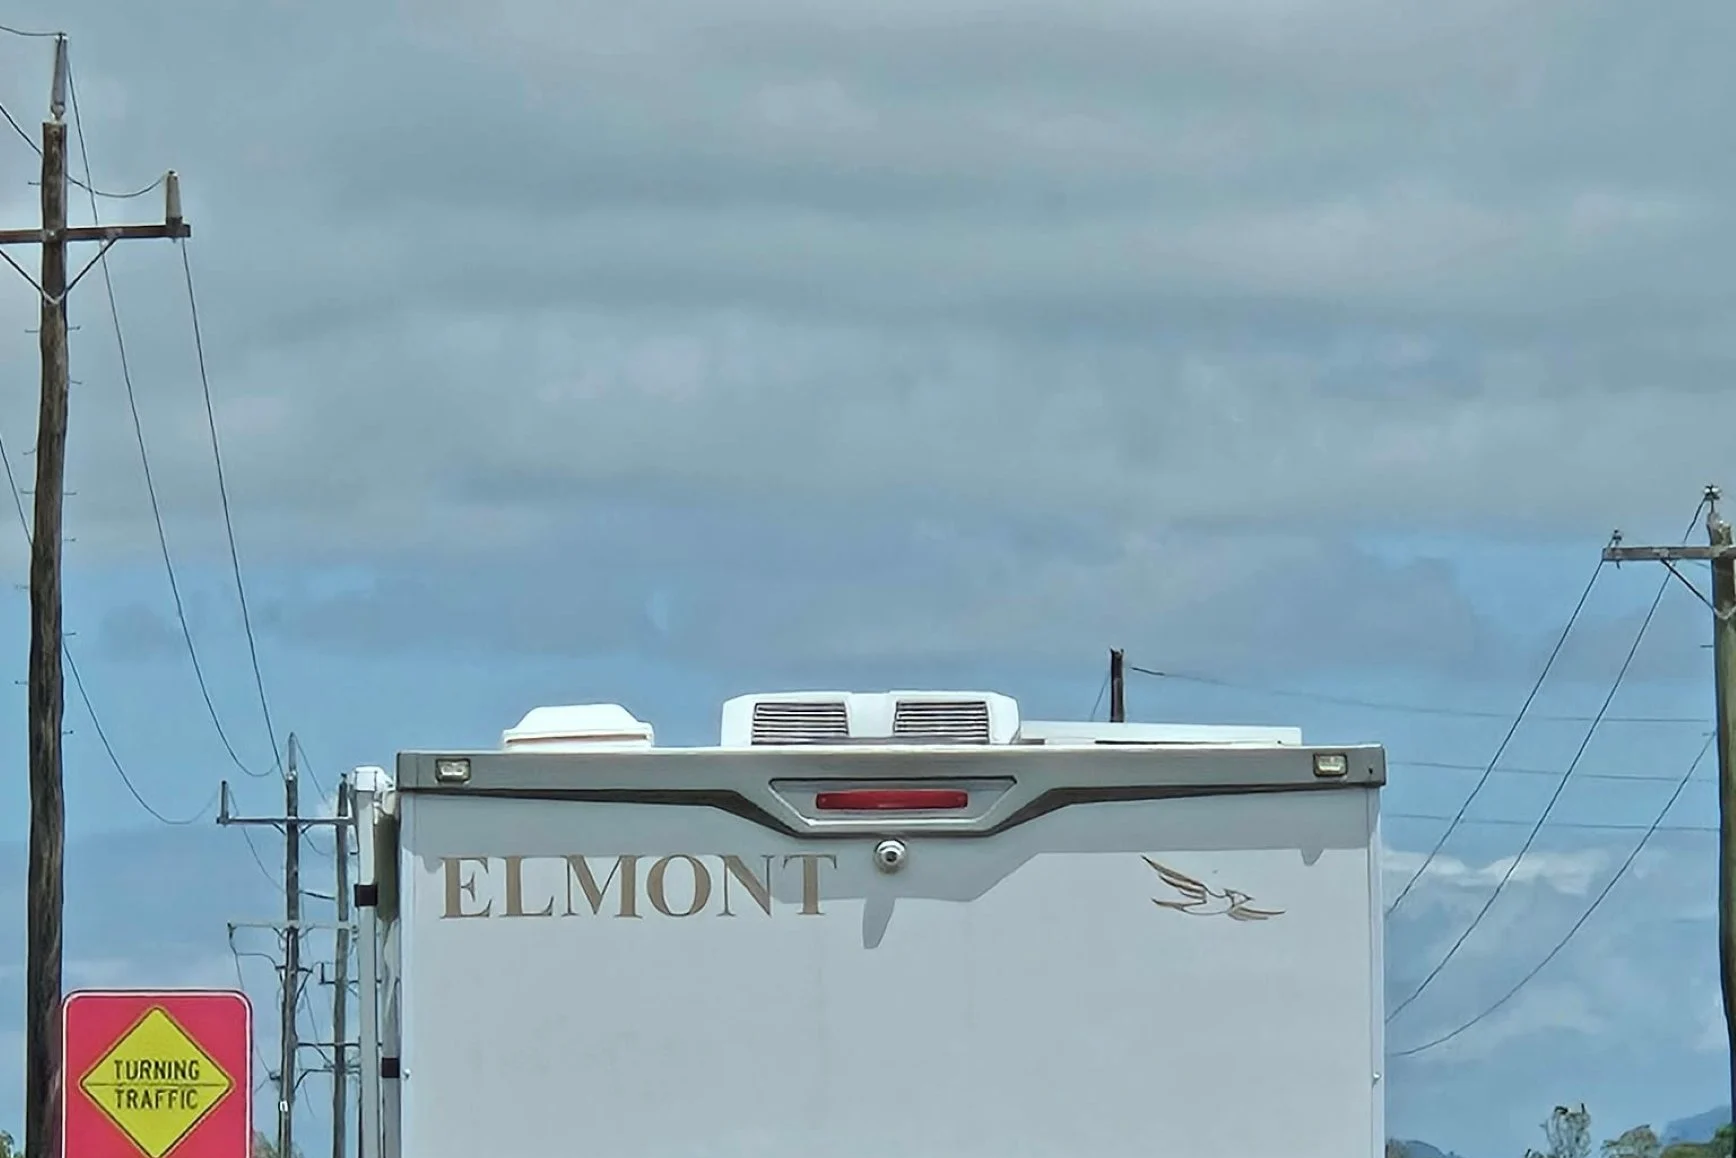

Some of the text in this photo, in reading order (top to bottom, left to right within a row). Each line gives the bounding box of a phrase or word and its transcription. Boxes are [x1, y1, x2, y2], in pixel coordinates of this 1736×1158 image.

[441, 854, 838, 919] ELMONT
[113, 1059, 200, 1081] TURNING
[115, 1089, 198, 1109] TRAFFIC
